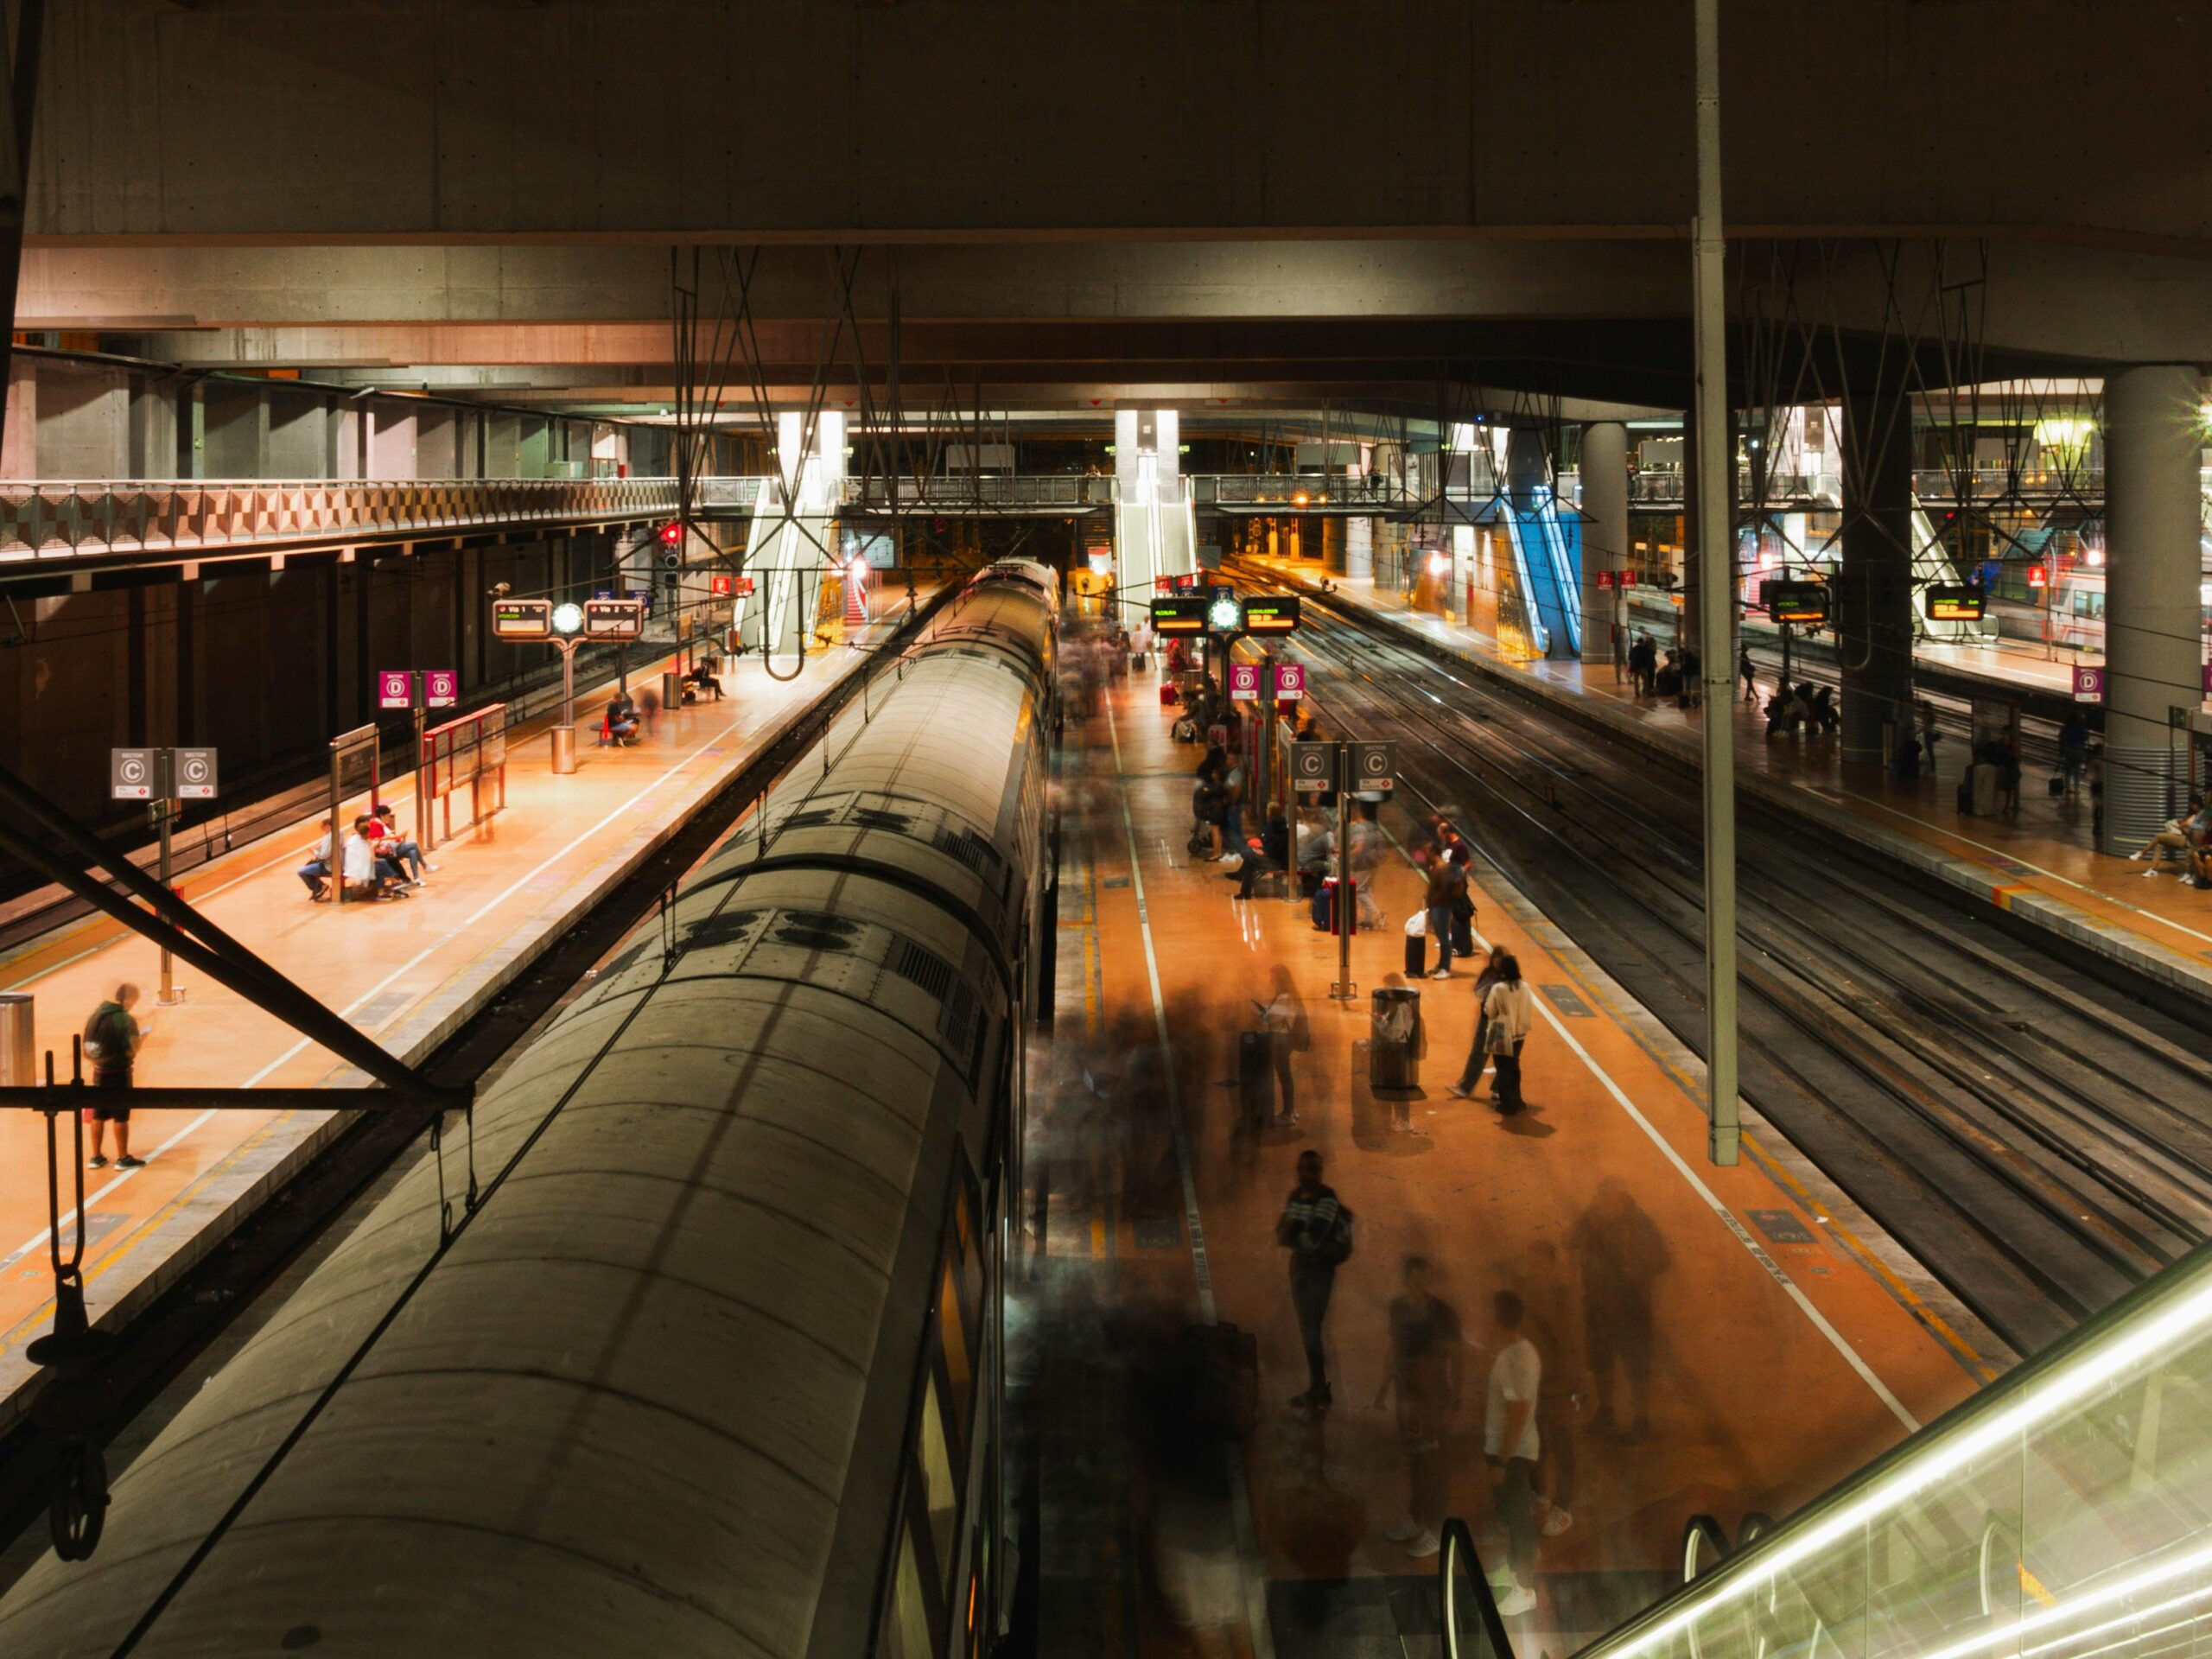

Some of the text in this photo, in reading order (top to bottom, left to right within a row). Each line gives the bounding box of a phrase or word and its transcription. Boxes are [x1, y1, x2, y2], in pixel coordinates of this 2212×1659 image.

[1240, 674, 1250, 686] D
[1285, 674, 1296, 686] D
[2083, 676, 2094, 688] D
[391, 682, 402, 694] D
[437, 681, 448, 693] D
[1305, 756, 1319, 772] C
[1369, 756, 1382, 772] C
[125, 762, 140, 779] C
[188, 762, 203, 779] C
